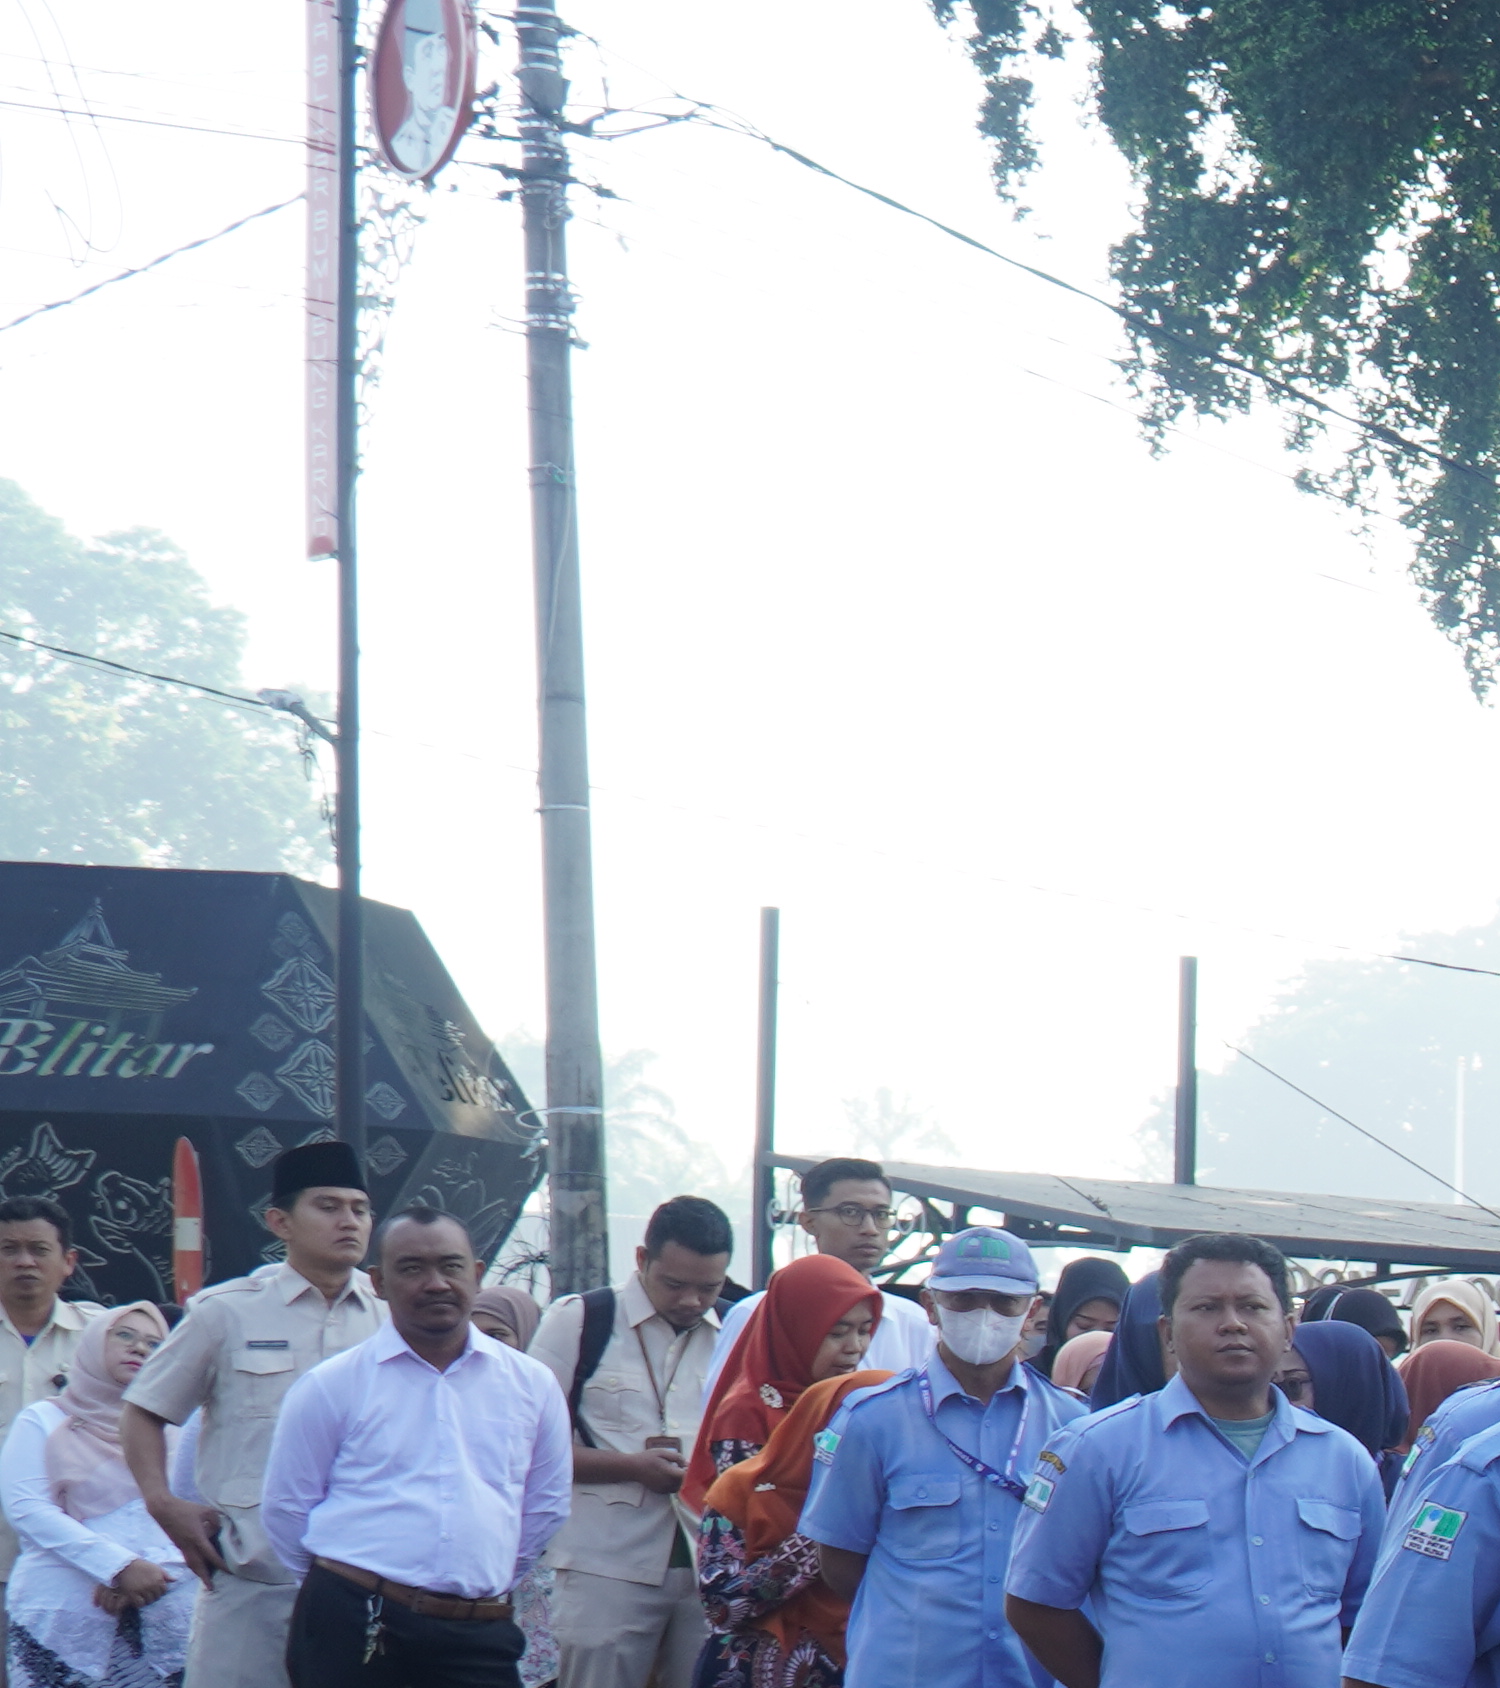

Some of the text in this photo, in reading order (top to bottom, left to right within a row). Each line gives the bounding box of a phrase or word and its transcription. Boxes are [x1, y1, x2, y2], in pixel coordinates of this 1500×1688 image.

[312, 209, 329, 298] BUMI
[312, 315, 328, 409] BUNG
[311, 419, 328, 536] KARNO
